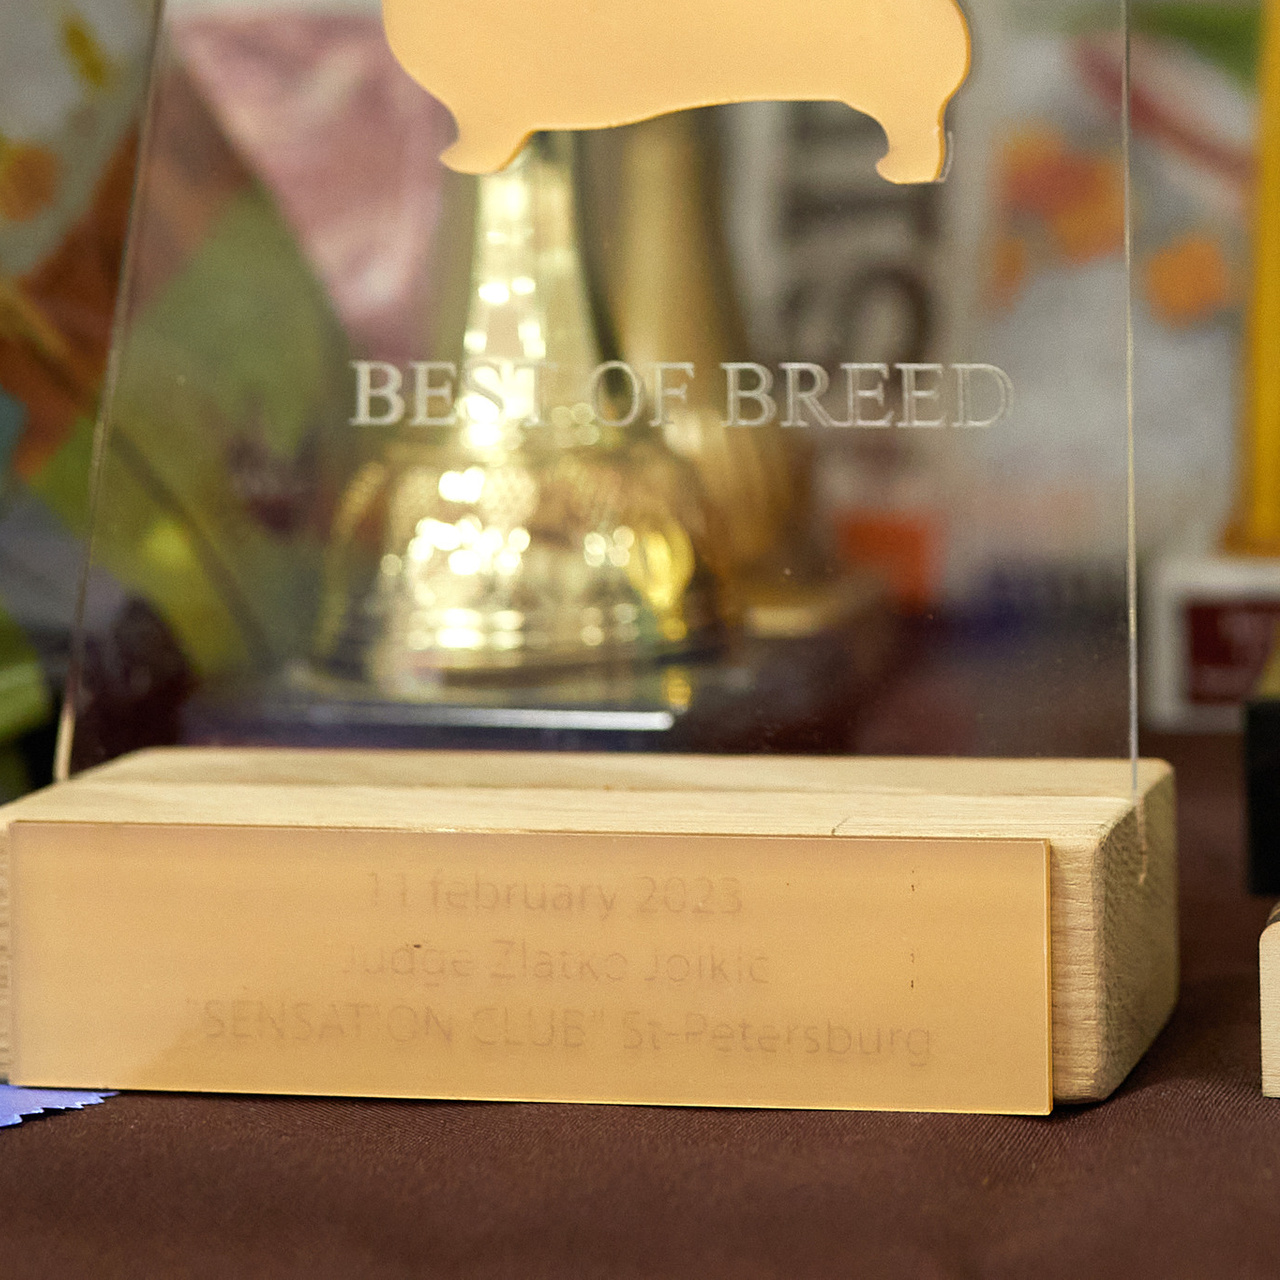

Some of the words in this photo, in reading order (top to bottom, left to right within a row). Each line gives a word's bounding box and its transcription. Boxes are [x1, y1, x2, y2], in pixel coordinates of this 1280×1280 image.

[348, 360, 558, 427] BEST
[592, 360, 696, 427] OF
[719, 361, 1016, 428] BREED
[367, 871, 409, 908] 11
[429, 869, 618, 922] february
[635, 875, 744, 916] 2023
[341, 941, 475, 988] Judge
[489, 938, 629, 983] Zlatko
[622, 1010, 933, 1067] St-Petersburg
